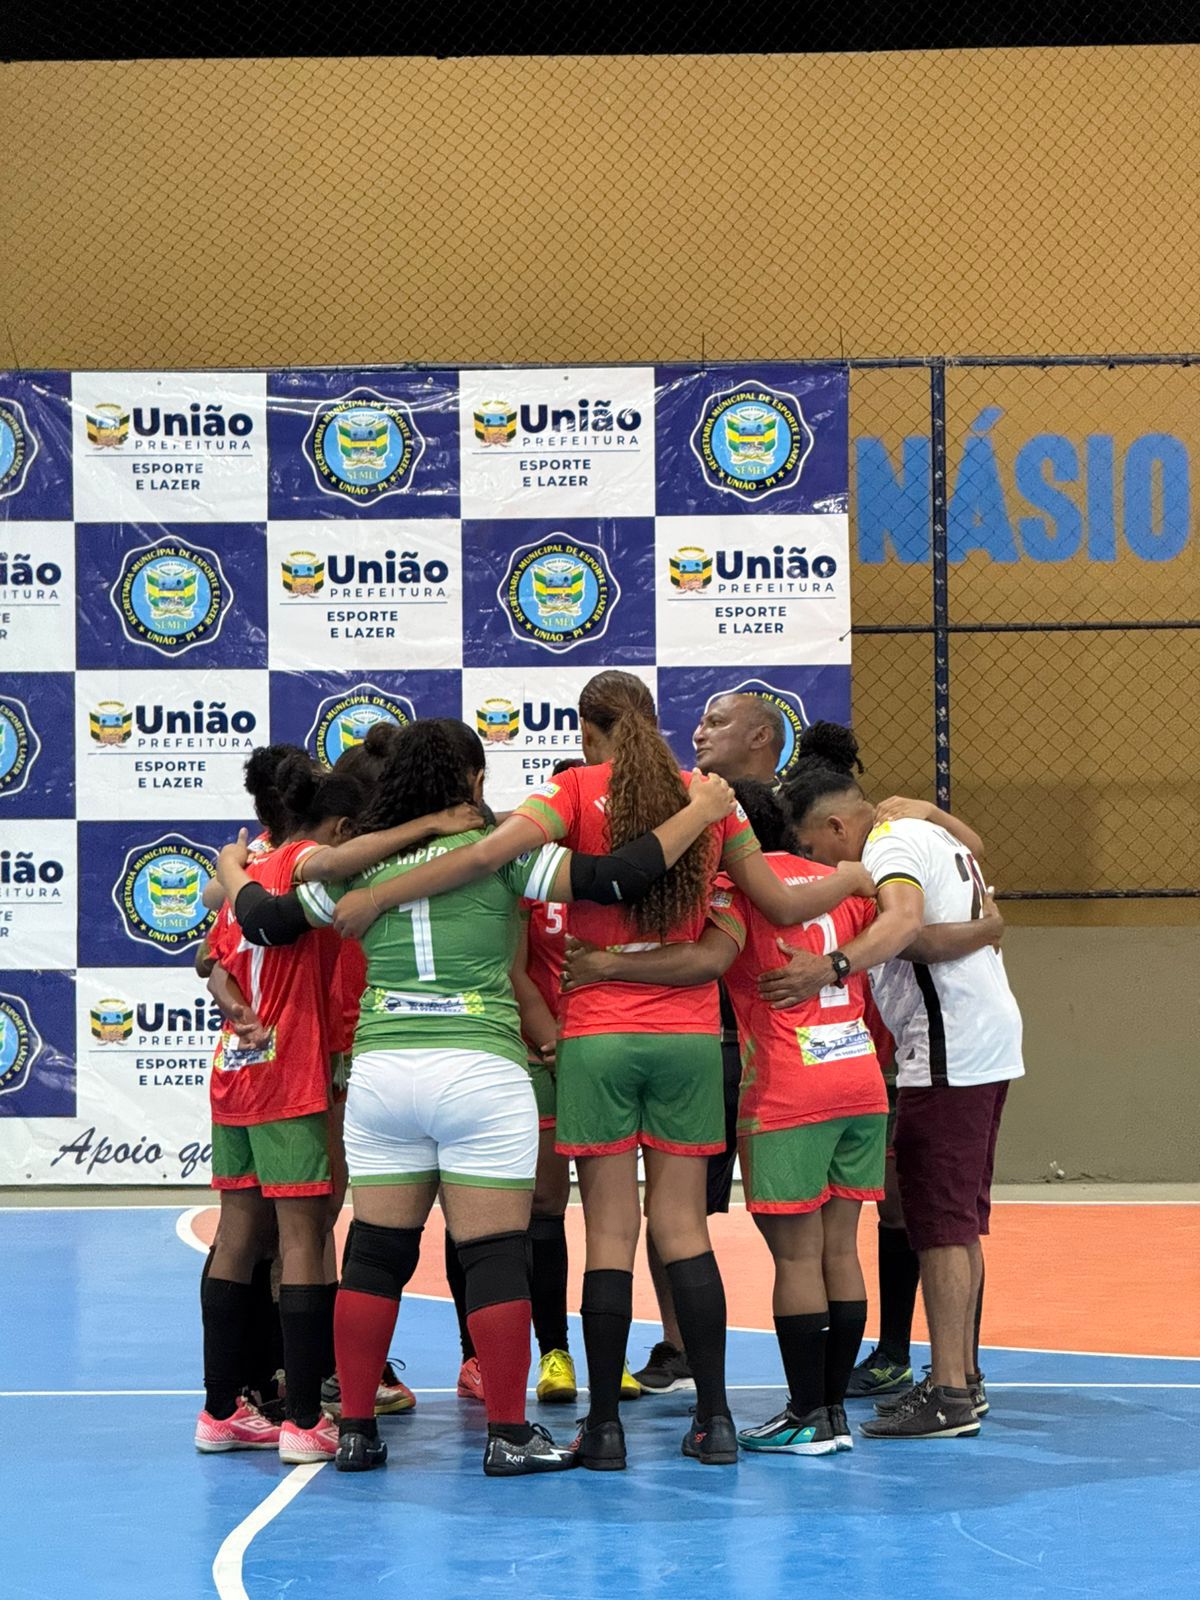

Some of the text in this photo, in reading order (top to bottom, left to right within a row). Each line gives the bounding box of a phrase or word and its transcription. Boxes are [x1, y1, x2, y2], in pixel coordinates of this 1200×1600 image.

[711, 393, 755, 417] MUNICIPAL
[758, 393, 773, 402] DE
[0, 408, 23, 439] SPORTE
[133, 403, 253, 436] União
[520, 399, 641, 433] União
[771, 399, 799, 433] ESPORTE
[135, 440, 251, 450] PREFEITURA
[314, 424, 330, 475] SECRETARIA
[397, 447, 411, 476] LAZER
[523, 436, 638, 446] PREFEITURA
[702, 418, 718, 470] SECRETARIA
[132, 463, 203, 474] ESPORTE
[520, 459, 591, 471] ESPORTE
[784, 442, 799, 470] LAZER
[136, 479, 200, 490] E LAZER
[523, 476, 588, 487] E LAZER
[856, 406, 1190, 563] NÁSIO
[132, 548, 175, 572] MUNICIPAL
[179, 549, 192, 558] DE
[518, 545, 563, 570] MUNICIPAL
[566, 546, 578, 556] DE
[716, 545, 836, 580] União
[0, 552, 61, 586] ião
[192, 556, 218, 588] ESPORTE
[328, 550, 448, 584] União
[579, 551, 606, 584] ESPORTE
[3, 589, 58, 599] ITURA
[122, 573, 138, 625] SECRETARIA
[330, 587, 445, 598] PREFEITURA
[509, 570, 524, 623] SECRETARIA
[718, 583, 834, 593] PREFEITURA
[204, 597, 219, 625] LAZER
[327, 611, 398, 622] ESPORTE
[591, 595, 607, 622] LAZER
[715, 606, 786, 617] ESPORTE
[331, 627, 395, 638] E LAZER
[719, 623, 783, 634] E LAZER
[136, 700, 256, 734] União
[326, 696, 369, 720] MUNICIPAL
[372, 696, 386, 706] DE
[386, 703, 410, 728] ESPOR
[762, 690, 775, 700] DE
[775, 698, 802, 732] ESPORTE
[138, 738, 253, 748] PREFEITURA
[526, 735, 582, 744] PREFE
[12, 748, 27, 775] LAZER
[135, 761, 205, 772] ESPORTE
[138, 777, 203, 788] E LAZER
[526, 775, 534, 785] E
[0, 850, 63, 884] ião
[0, 888, 60, 897] ITURA
[125, 846, 223, 923] SECRETARIA MUNICIPAL DE ESPOR
[546, 902, 562, 934] 5
[399, 898, 436, 981] 1
[139, 1036, 216, 1046] PREFEIT
[13, 1045, 28, 1072] LAZER
[136, 1059, 206, 1069] ESPORTE
[139, 1075, 204, 1085] E LAZER
[51, 1126, 163, 1176] Apoio
